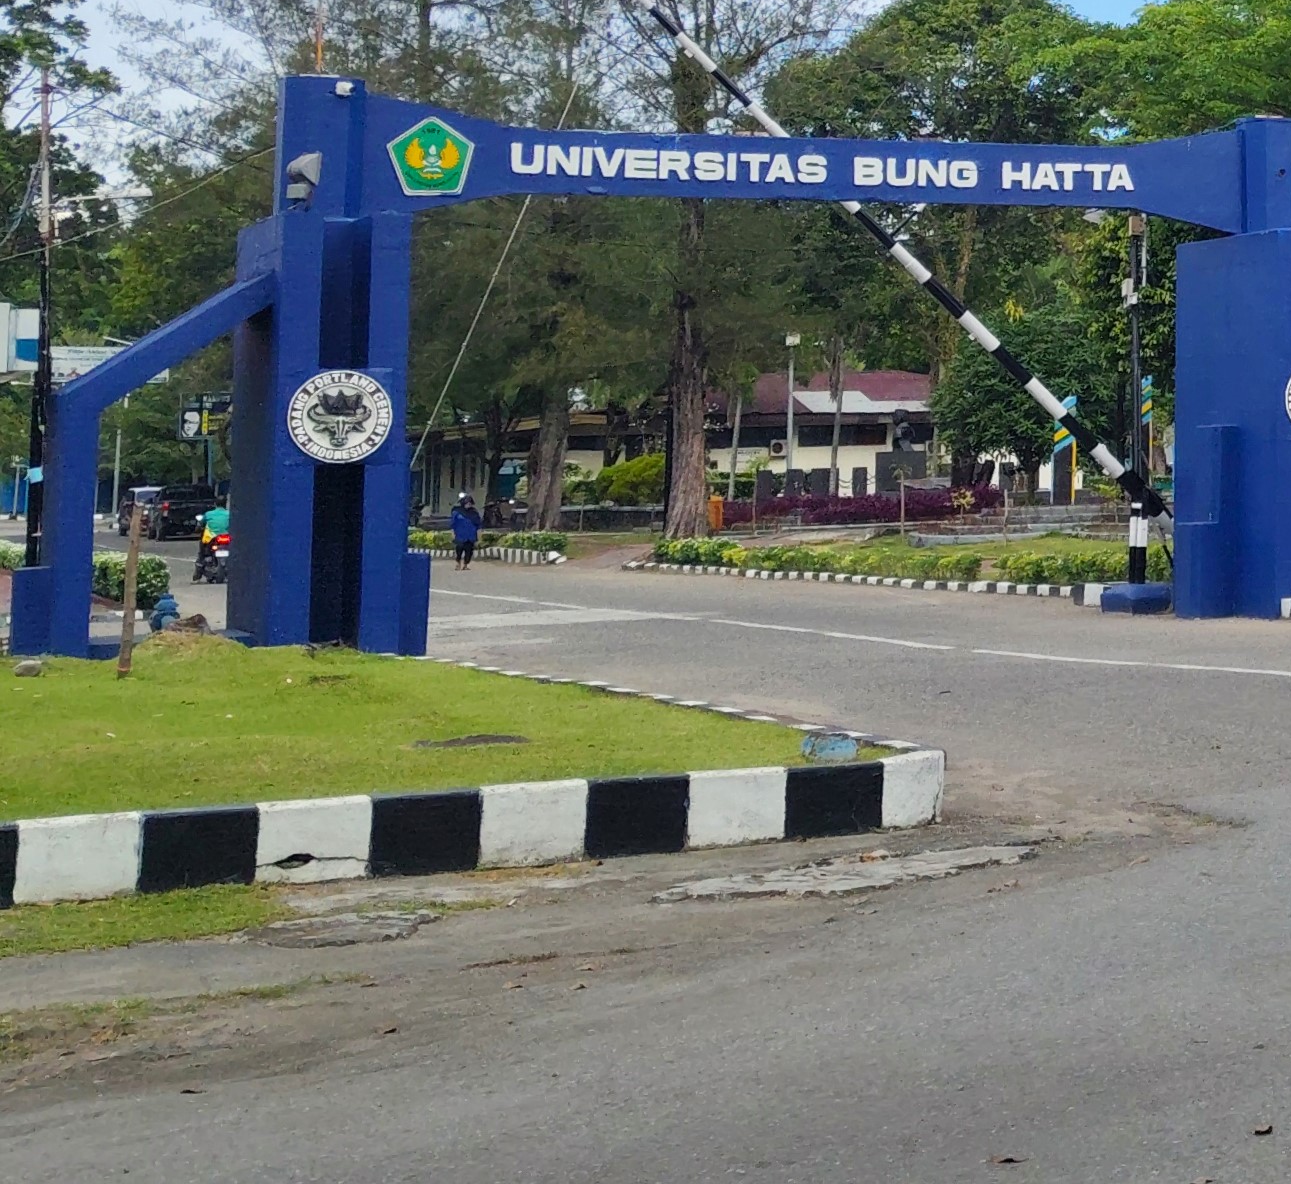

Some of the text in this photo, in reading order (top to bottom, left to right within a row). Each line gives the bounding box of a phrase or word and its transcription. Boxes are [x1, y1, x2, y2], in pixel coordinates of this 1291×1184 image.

[510, 142, 1135, 191] UNIVERSITAS BUNG HATTA
[291, 373, 389, 445] PADANG PORTLAND CEMENT
[305, 442, 371, 460] INDONESIA
